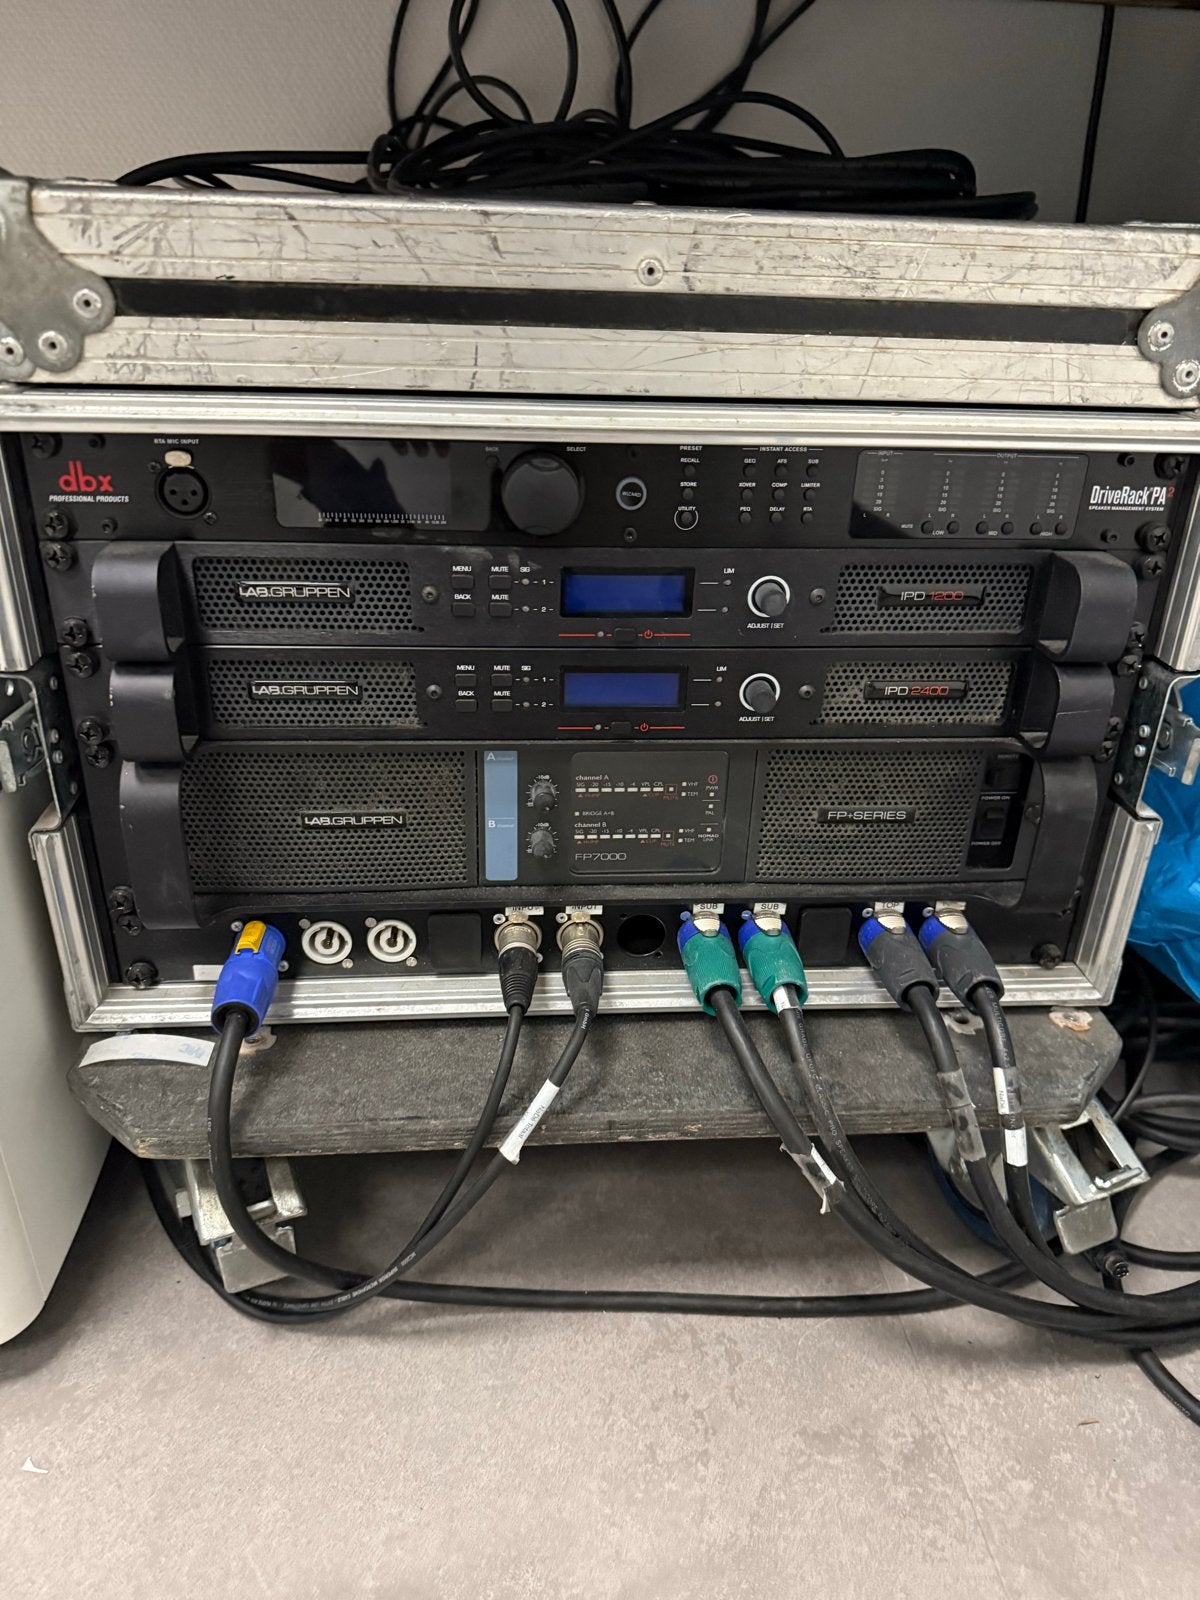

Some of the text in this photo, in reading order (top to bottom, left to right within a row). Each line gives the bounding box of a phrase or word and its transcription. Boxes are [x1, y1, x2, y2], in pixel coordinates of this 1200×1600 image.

[58, 460, 114, 492] dbx
[900, 591, 964, 601] IPD 1200
[884, 686, 949, 696] IPD 2400
[487, 752, 496, 760] A
[575, 852, 627, 860] FP7000
[828, 1119, 838, 1136] PRO
